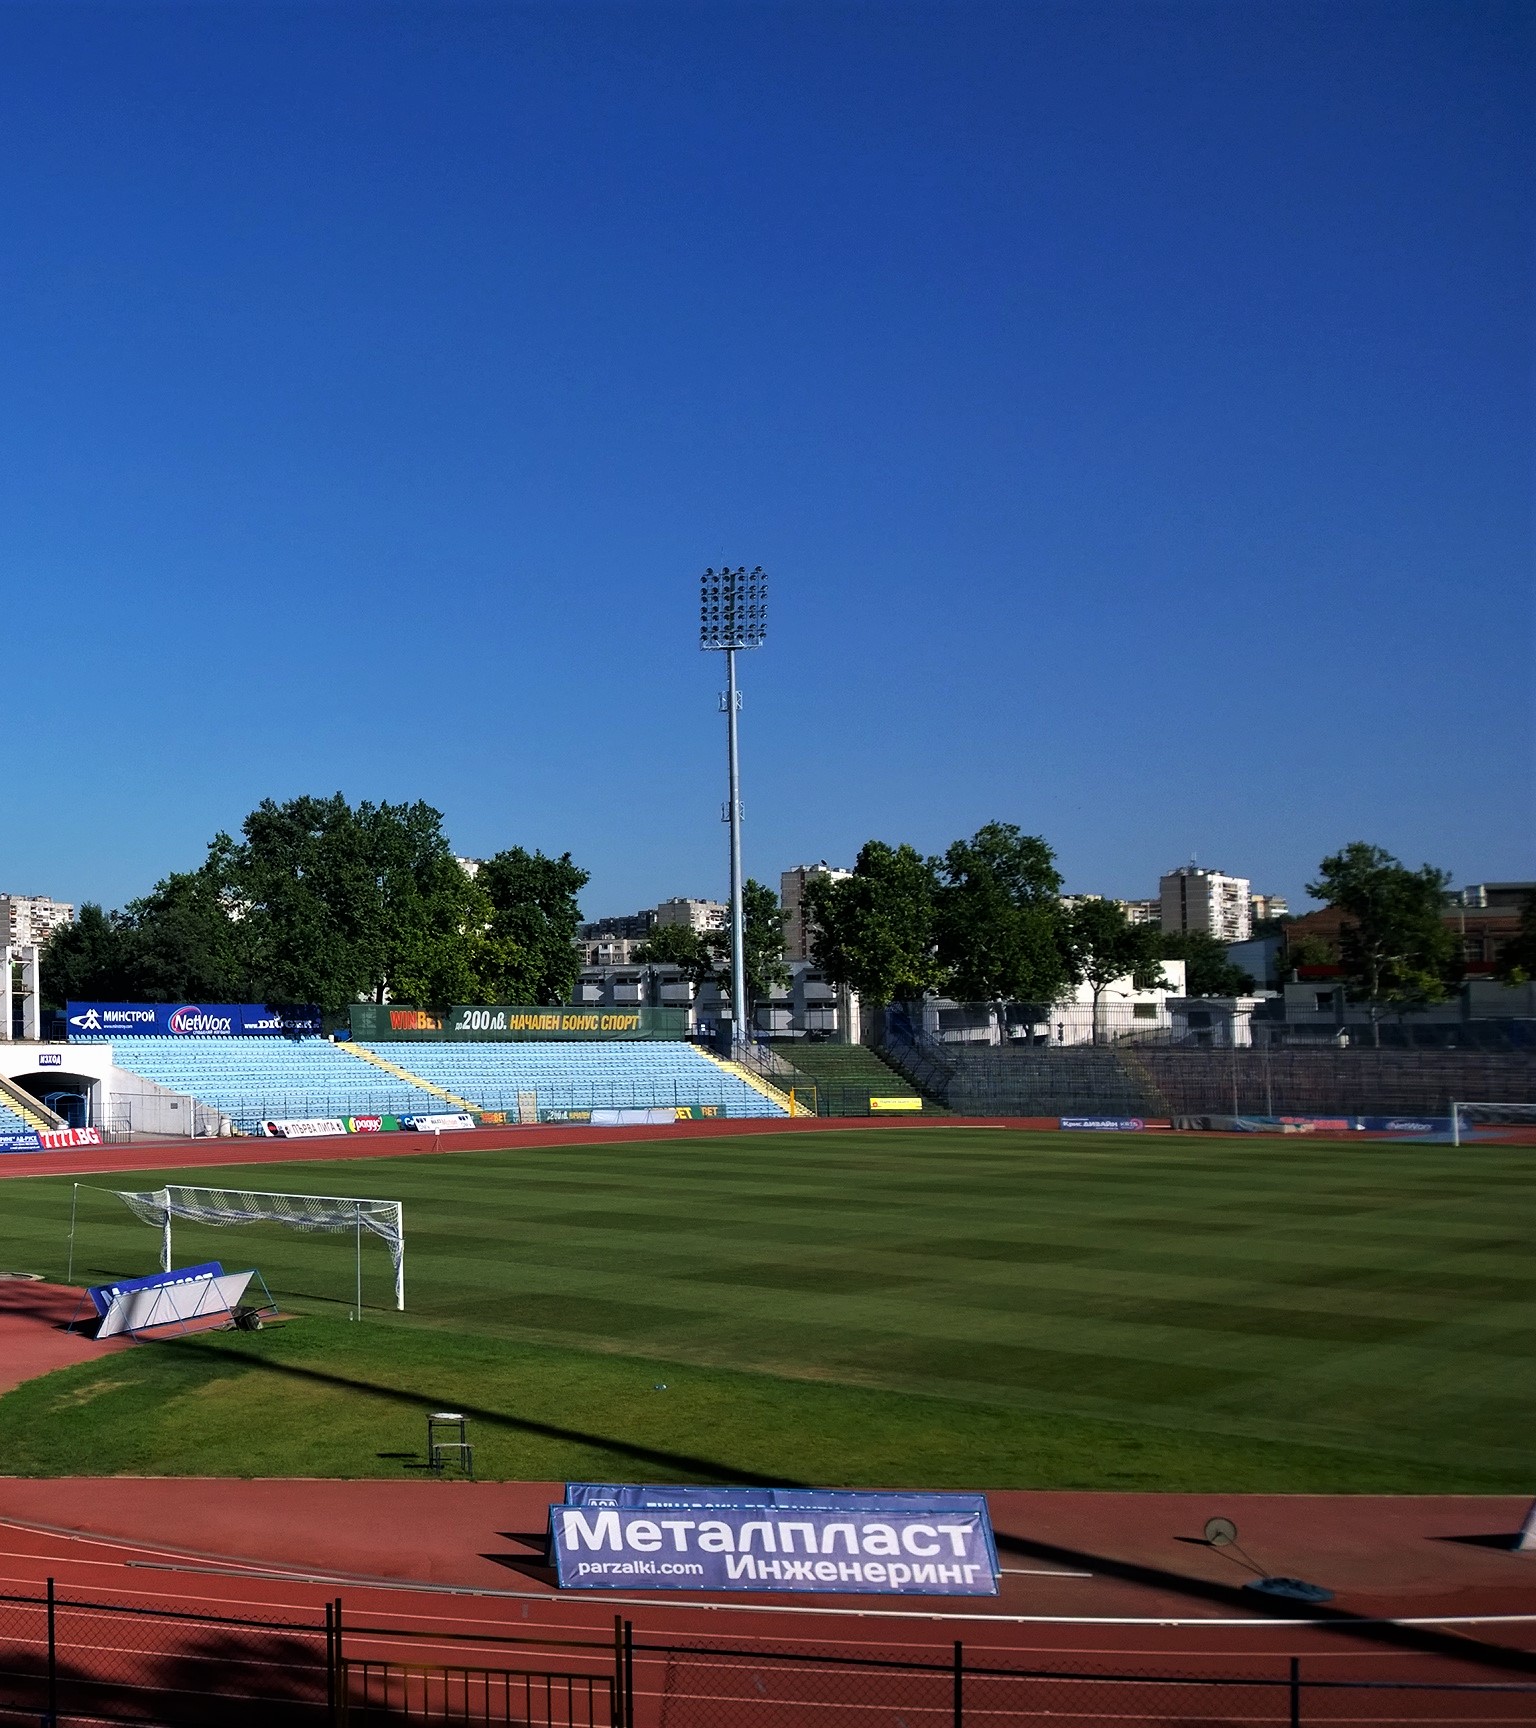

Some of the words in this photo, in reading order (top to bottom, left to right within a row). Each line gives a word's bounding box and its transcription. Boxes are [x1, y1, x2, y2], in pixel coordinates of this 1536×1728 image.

[103, 1009, 155, 1022] МИНСТРОЙ
[175, 1014, 231, 1030] NetWorx
[510, 1014, 560, 1030] НАЧАЛЕН
[562, 1015, 599, 1030] БОНУС
[601, 1014, 640, 1030] СПОРТ
[41, 1127, 99, 1149] 7777.BG
[563, 1510, 973, 1557] Металпласт
[578, 1560, 704, 1576] parzalki.com
[725, 1554, 981, 1588] Инженеринг
